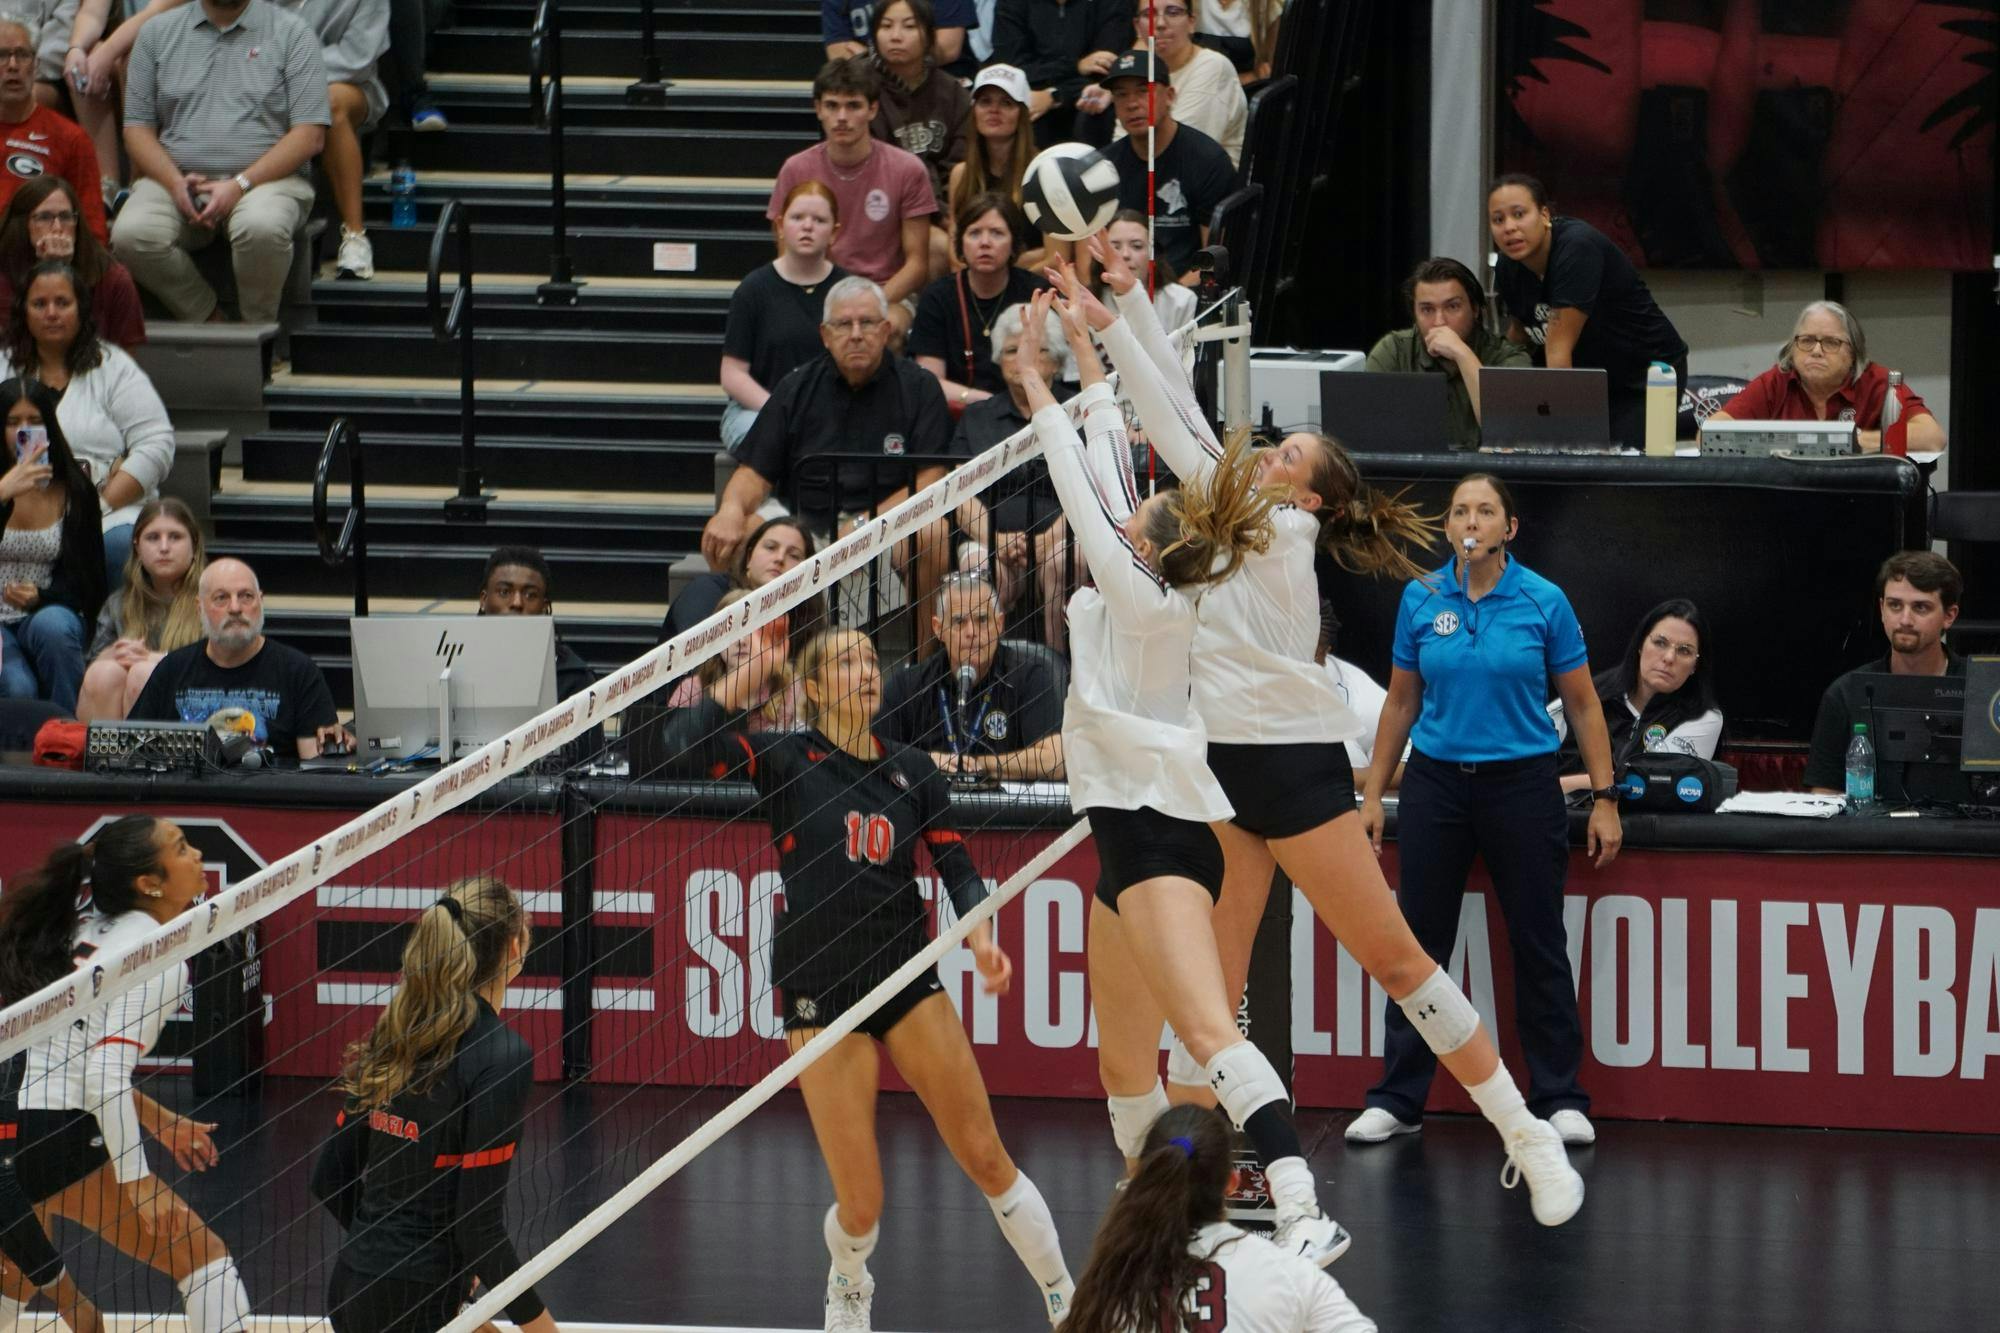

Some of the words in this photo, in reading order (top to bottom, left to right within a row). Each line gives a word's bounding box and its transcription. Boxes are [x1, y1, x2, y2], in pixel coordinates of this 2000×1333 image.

[1436, 613, 1457, 634] SEC
[436, 630, 464, 668] hp
[844, 811, 895, 865] 10
